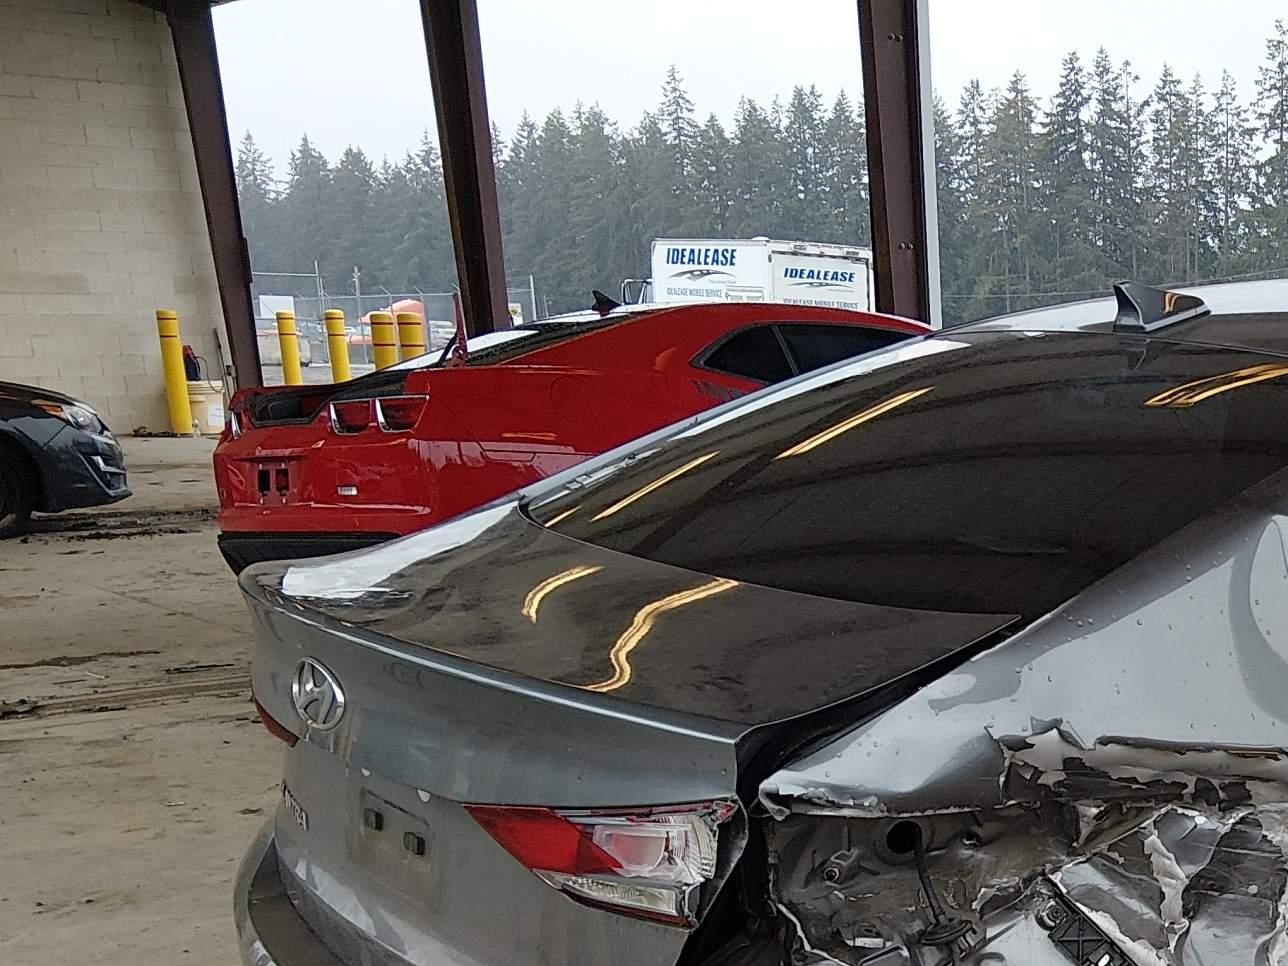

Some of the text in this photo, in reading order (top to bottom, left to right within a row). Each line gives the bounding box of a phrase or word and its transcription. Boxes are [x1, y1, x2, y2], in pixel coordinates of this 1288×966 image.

[666, 248, 737, 266] IDEALEASE
[783, 267, 856, 282] IDEALEASE
[667, 287, 722, 298] IDEALEASE MOBILE SERVICE
[836, 301, 859, 309] SERVICE
